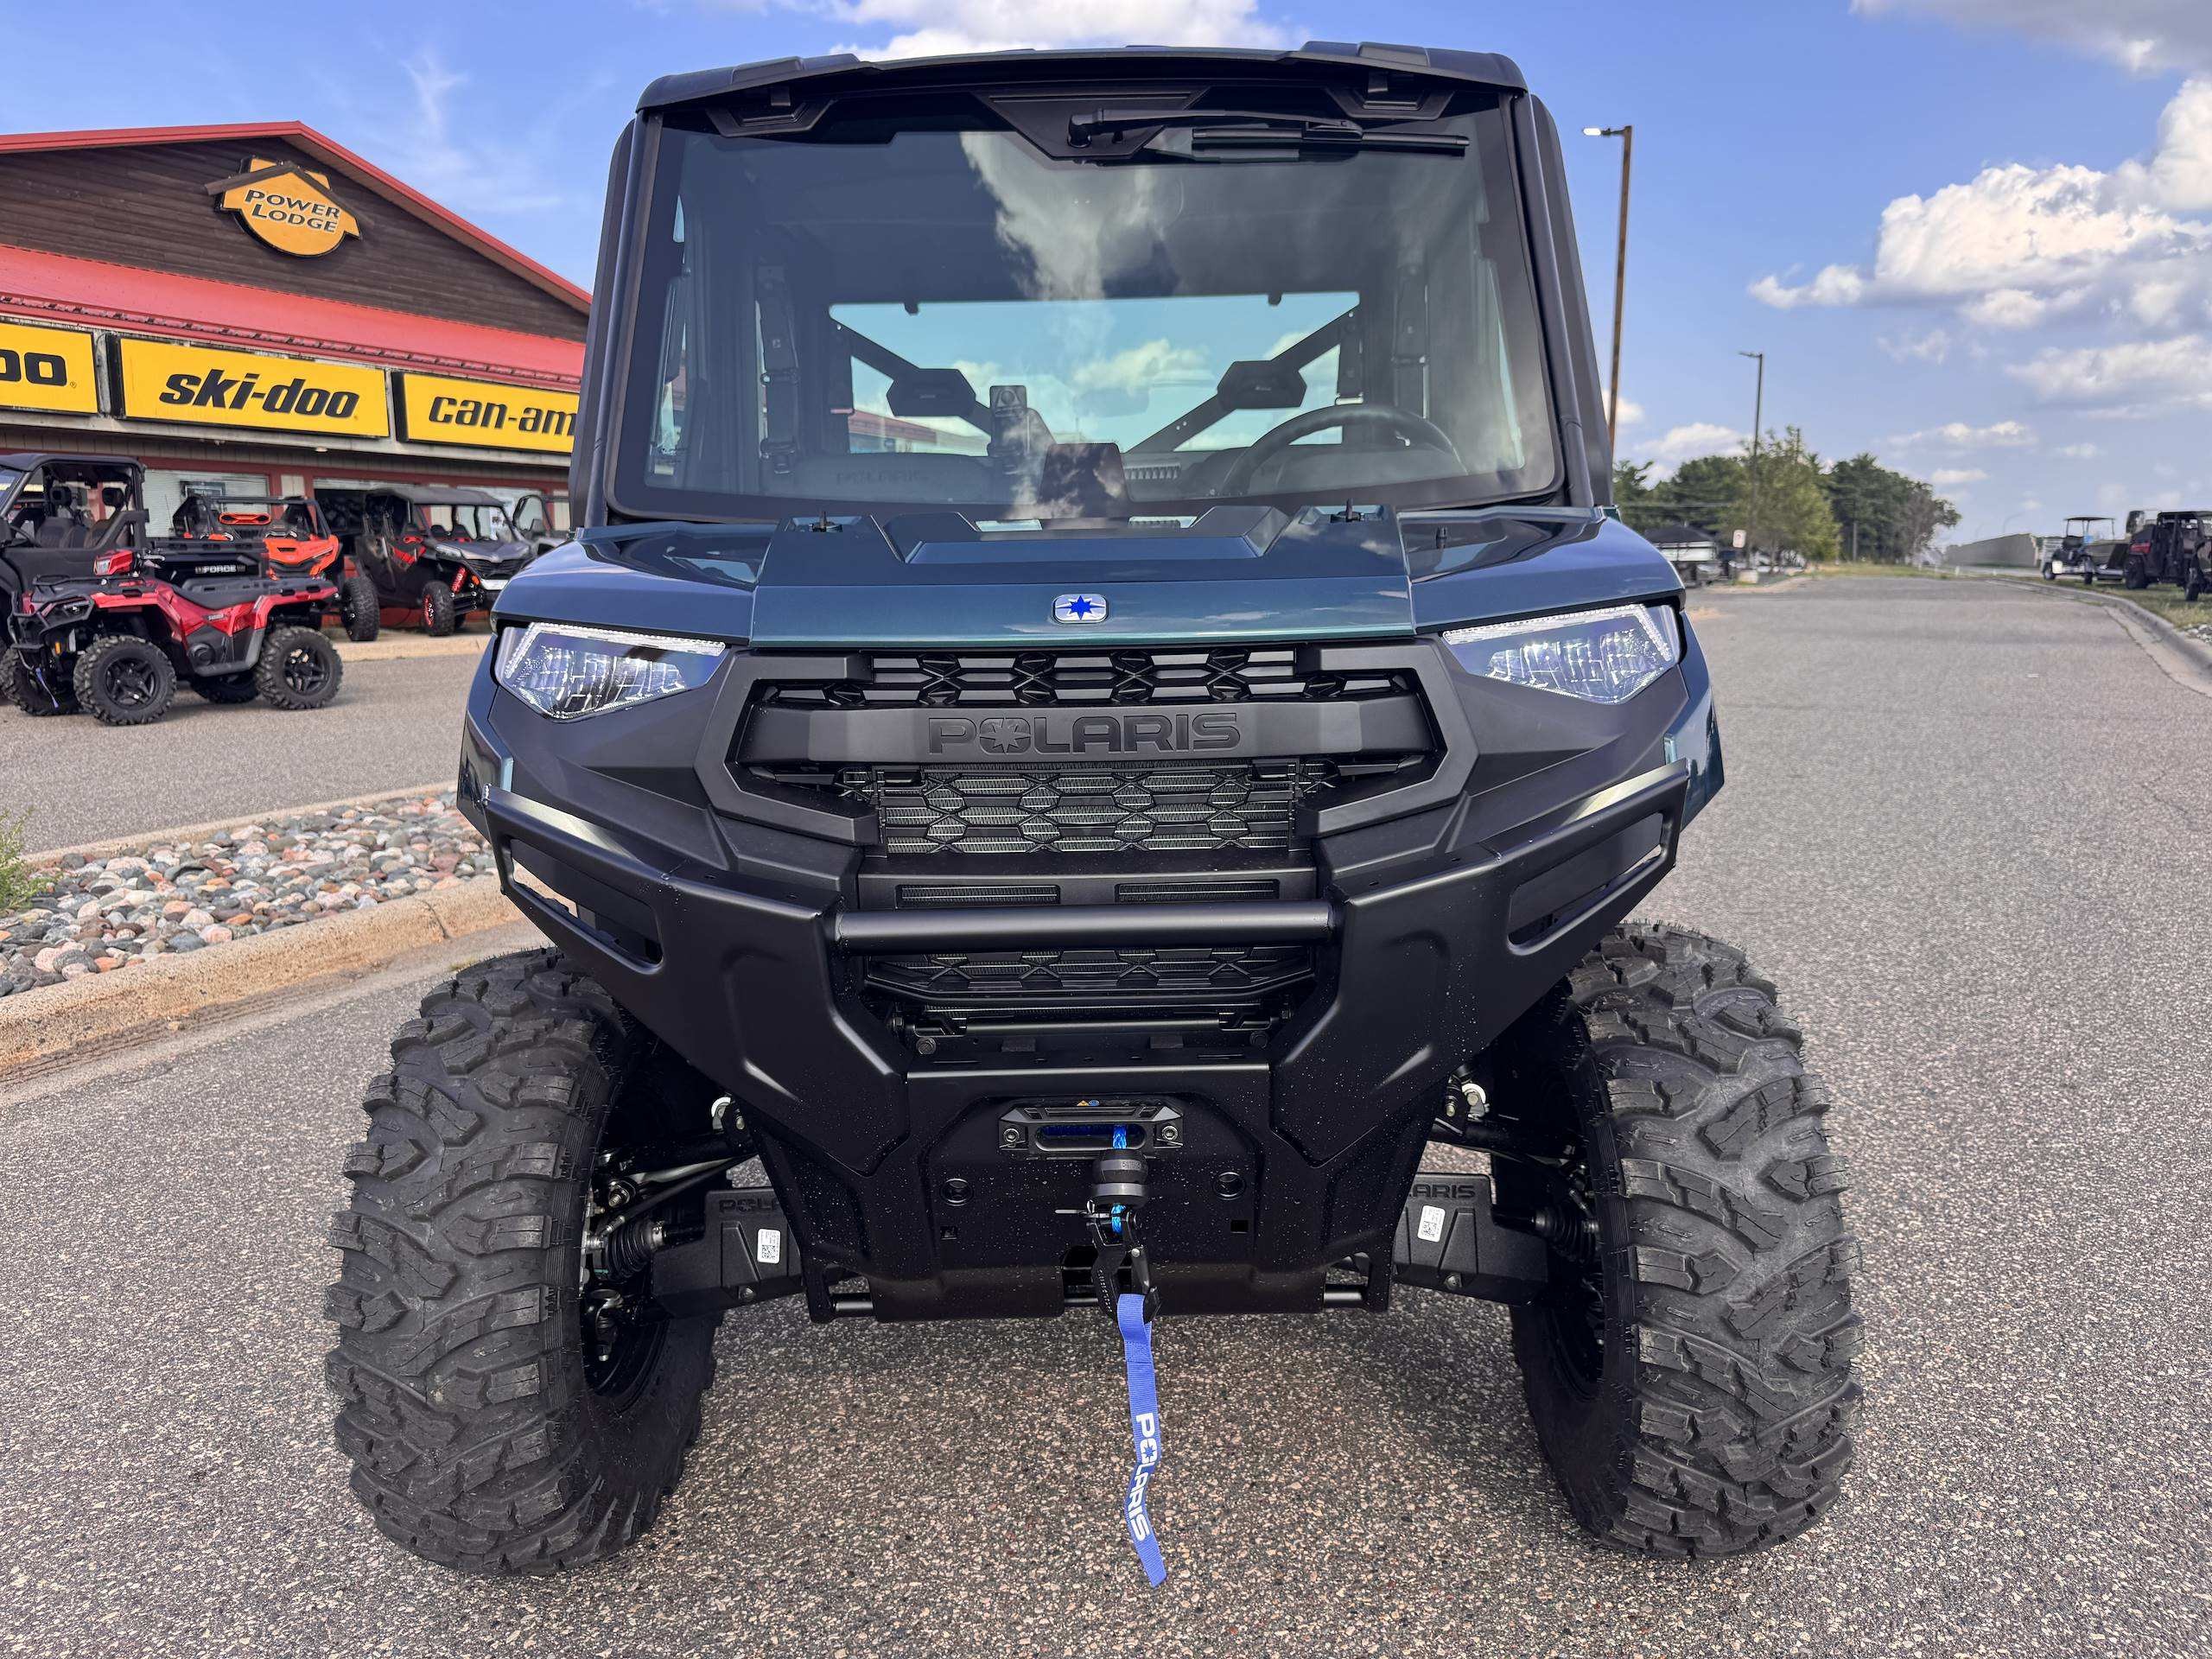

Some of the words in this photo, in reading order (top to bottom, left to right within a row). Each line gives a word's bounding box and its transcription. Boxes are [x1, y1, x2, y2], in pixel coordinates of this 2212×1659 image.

[245, 189, 340, 219] POWER
[252, 204, 338, 232] LODGE
[159, 368, 360, 418] ski-doo
[429, 396, 576, 436] can-am
[928, 713, 1241, 754] POLARIS
[1128, 1411, 1155, 1541] POLARIS
